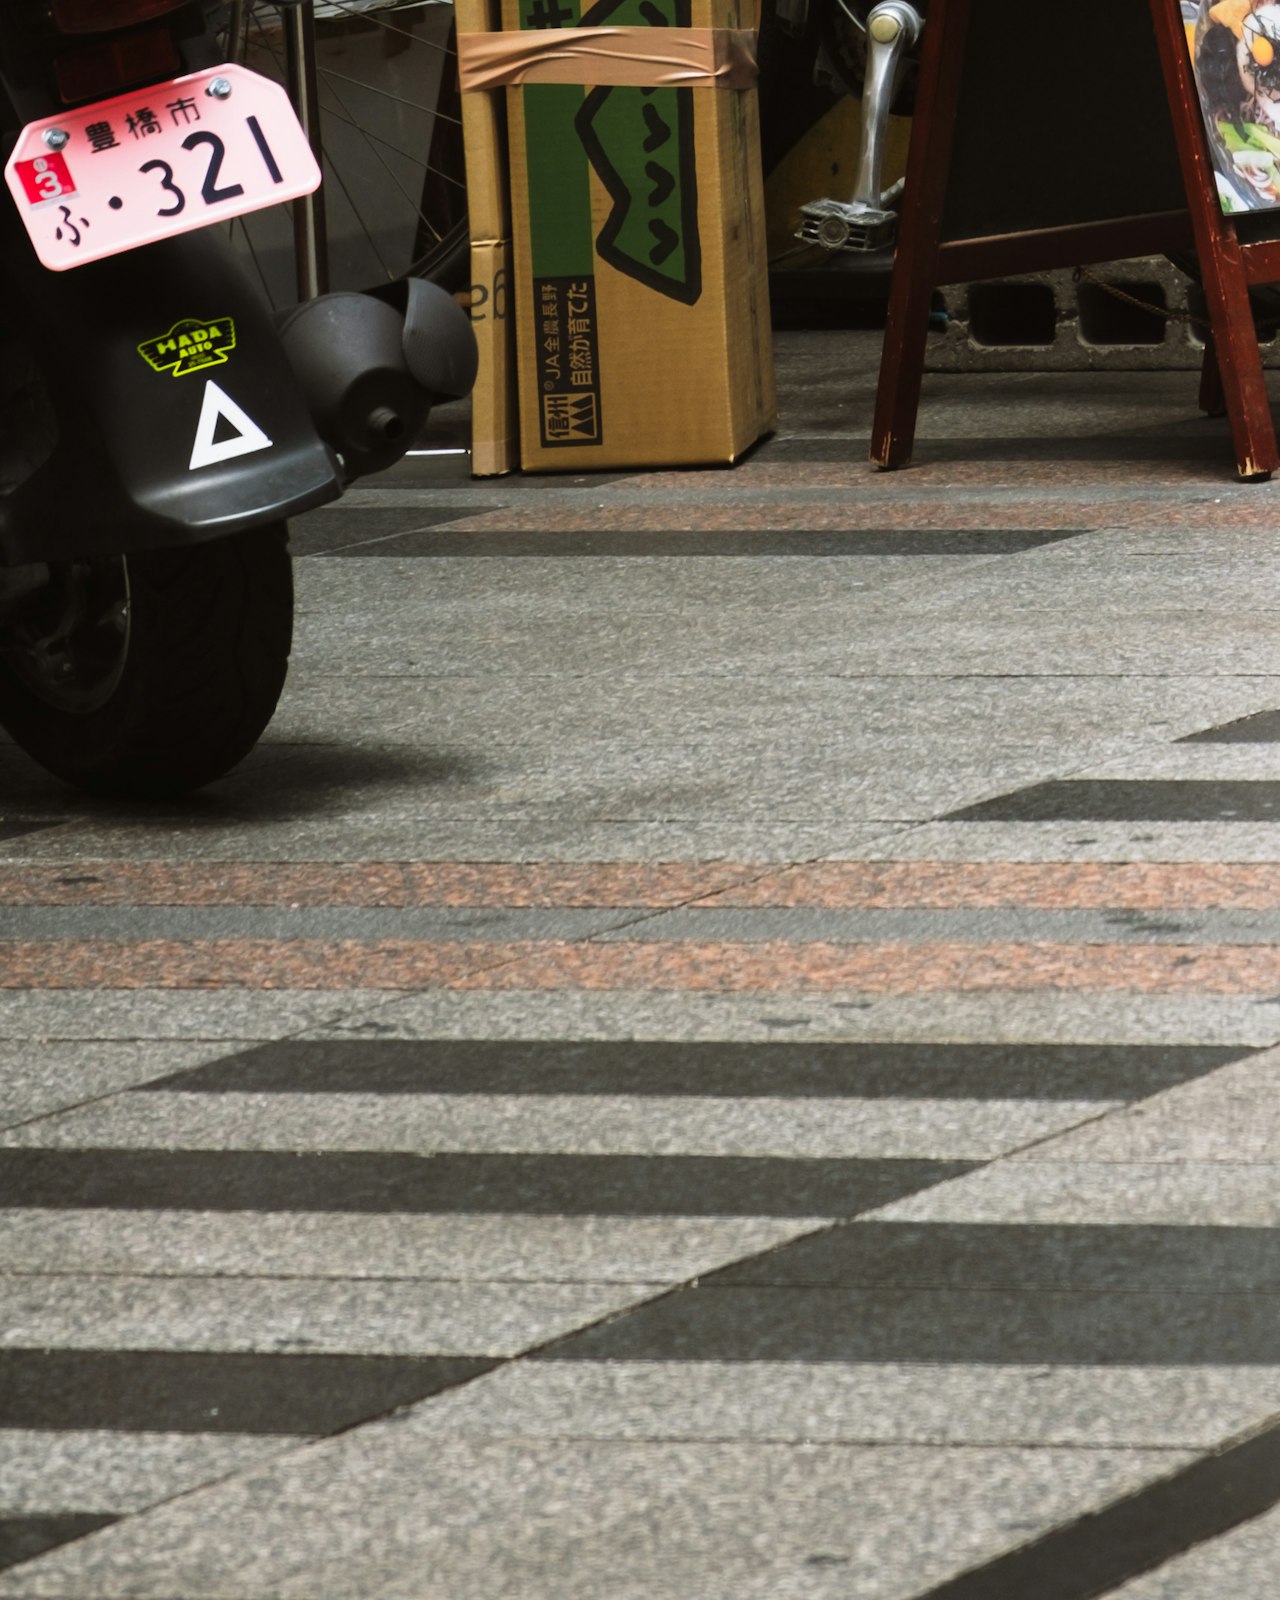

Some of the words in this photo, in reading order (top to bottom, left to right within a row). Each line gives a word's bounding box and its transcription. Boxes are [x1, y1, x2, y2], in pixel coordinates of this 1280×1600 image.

[83, 96, 202, 155] 豊橋市
[155, 324, 223, 355] HADA
[178, 340, 214, 360] AUTO
[566, 282, 594, 387] 自然が育てた
[545, 395, 570, 441] 信州
